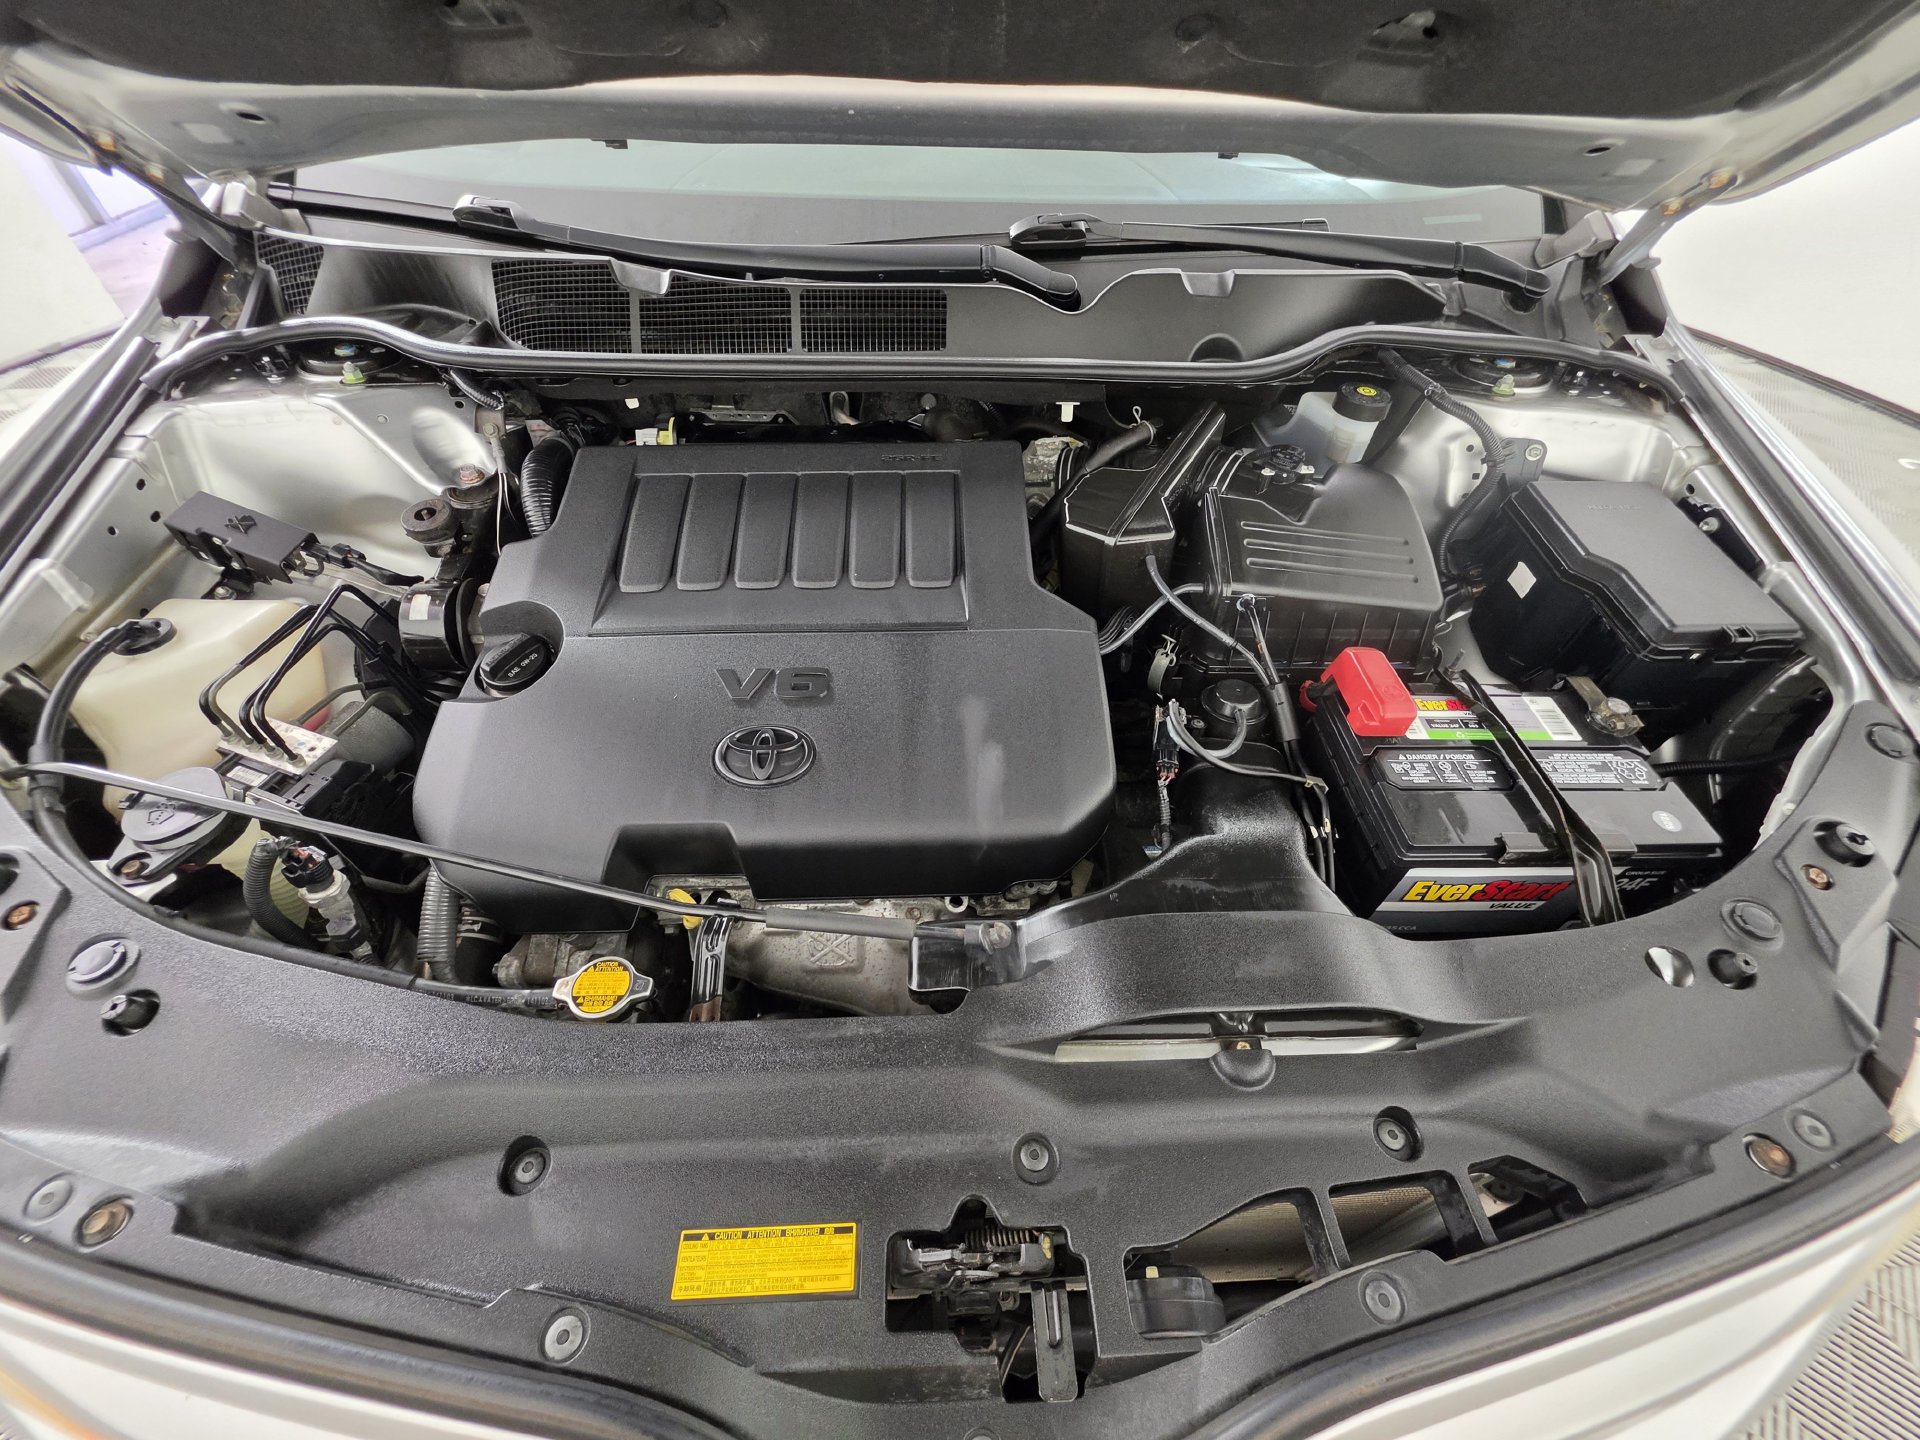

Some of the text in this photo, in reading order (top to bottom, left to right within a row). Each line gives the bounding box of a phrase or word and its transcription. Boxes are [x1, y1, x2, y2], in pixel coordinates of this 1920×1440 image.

[507, 666, 521, 678] SAE
[715, 667, 832, 700] V6
[1402, 880, 1574, 902] EverStart
[714, 1229, 782, 1240] CAUTION ATTENTION
